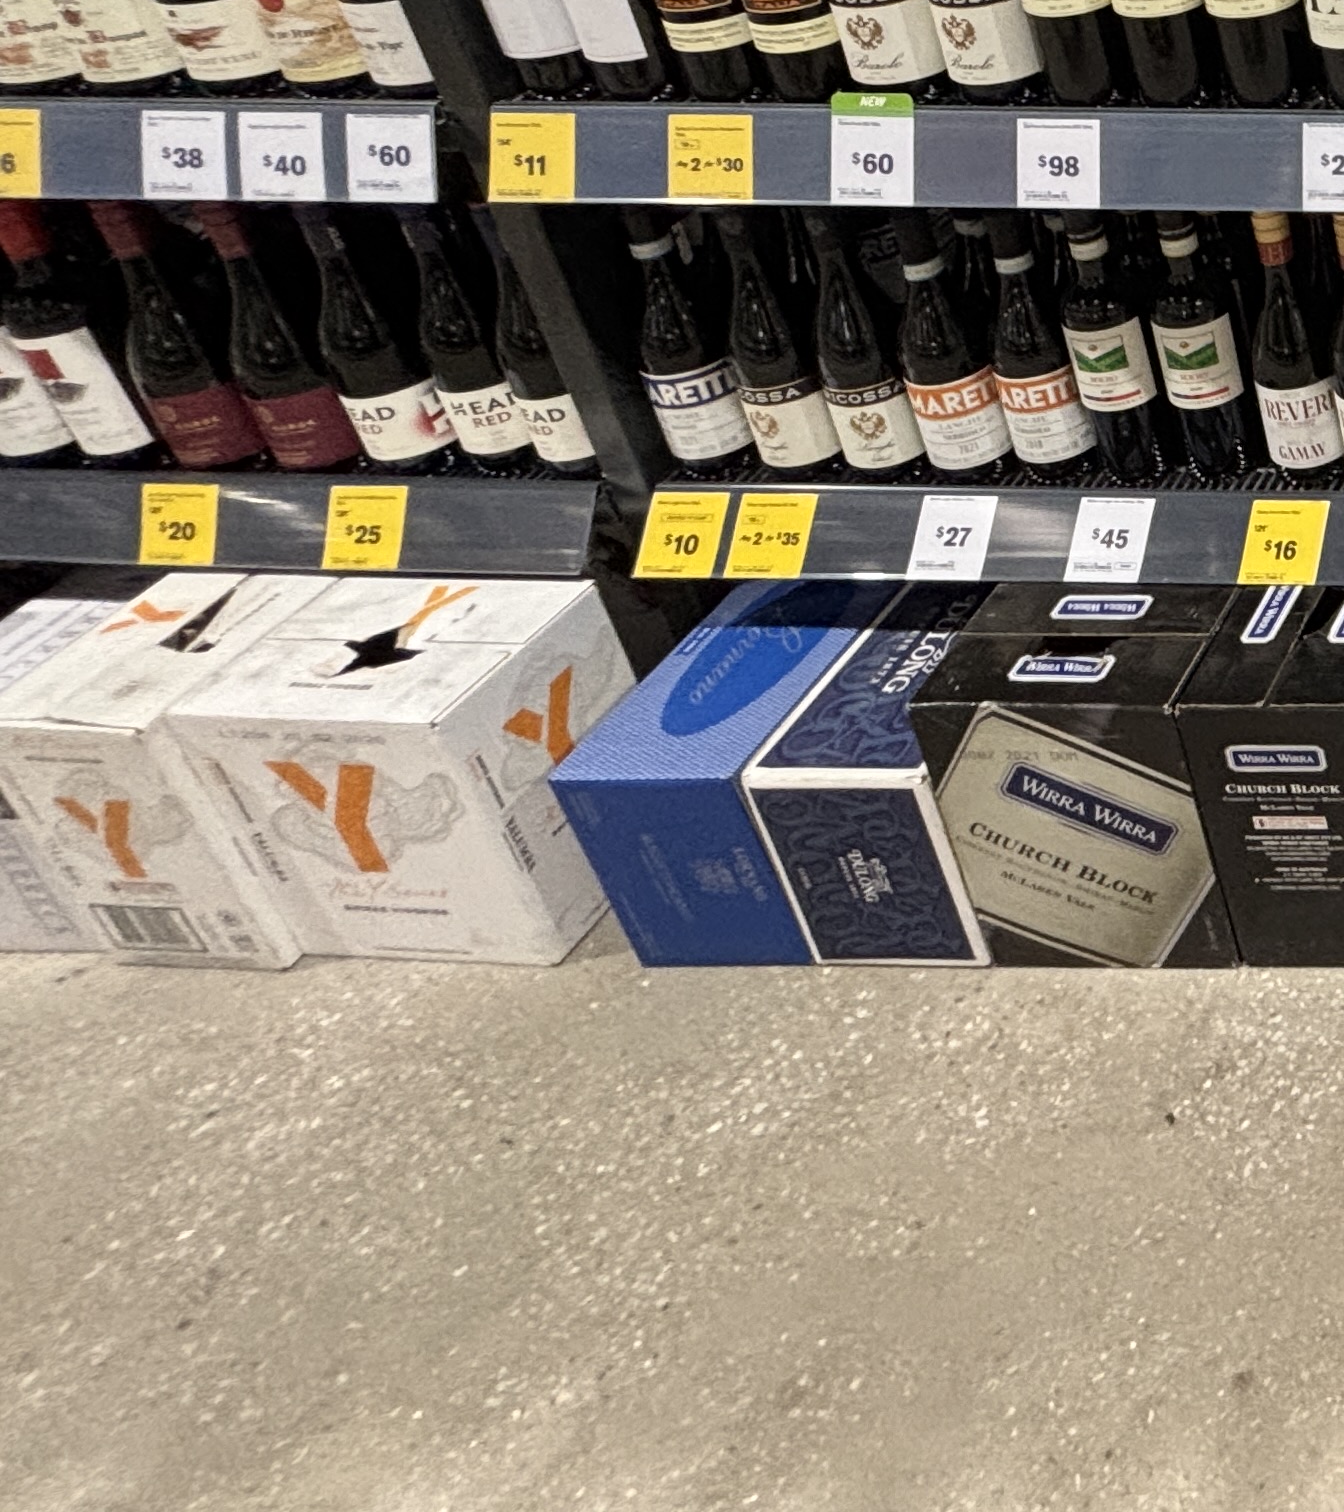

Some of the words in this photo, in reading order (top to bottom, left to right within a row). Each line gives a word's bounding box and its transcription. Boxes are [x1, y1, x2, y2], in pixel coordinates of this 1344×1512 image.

[850, 51, 905, 72] Barolo
[860, 95, 887, 108] NEW
[160, 145, 205, 170] $38
[262, 154, 307, 178] $40
[367, 143, 412, 168] $60
[513, 154, 547, 177] $11
[851, 151, 895, 176] $60
[1037, 153, 1080, 178] $98
[472, 409, 514, 430] RED
[159, 519, 196, 542] $20
[345, 523, 381, 546] $25
[936, 524, 974, 549] $27
[1091, 527, 1131, 551] $45
[663, 532, 700, 557] $10
[1263, 538, 1299, 562] $16
[1237, 752, 1276, 766] WIRRA
[1277, 752, 1315, 766] WIRRA
[1224, 782, 1287, 795] CHURCH
[1289, 782, 1341, 795] BLOCK
[1020, 775, 1087, 818] WIRRA
[1092, 803, 1159, 846] WIRRA
[968, 820, 1072, 874] CHURCH
[1074, 864, 1159, 906] BLOCK
